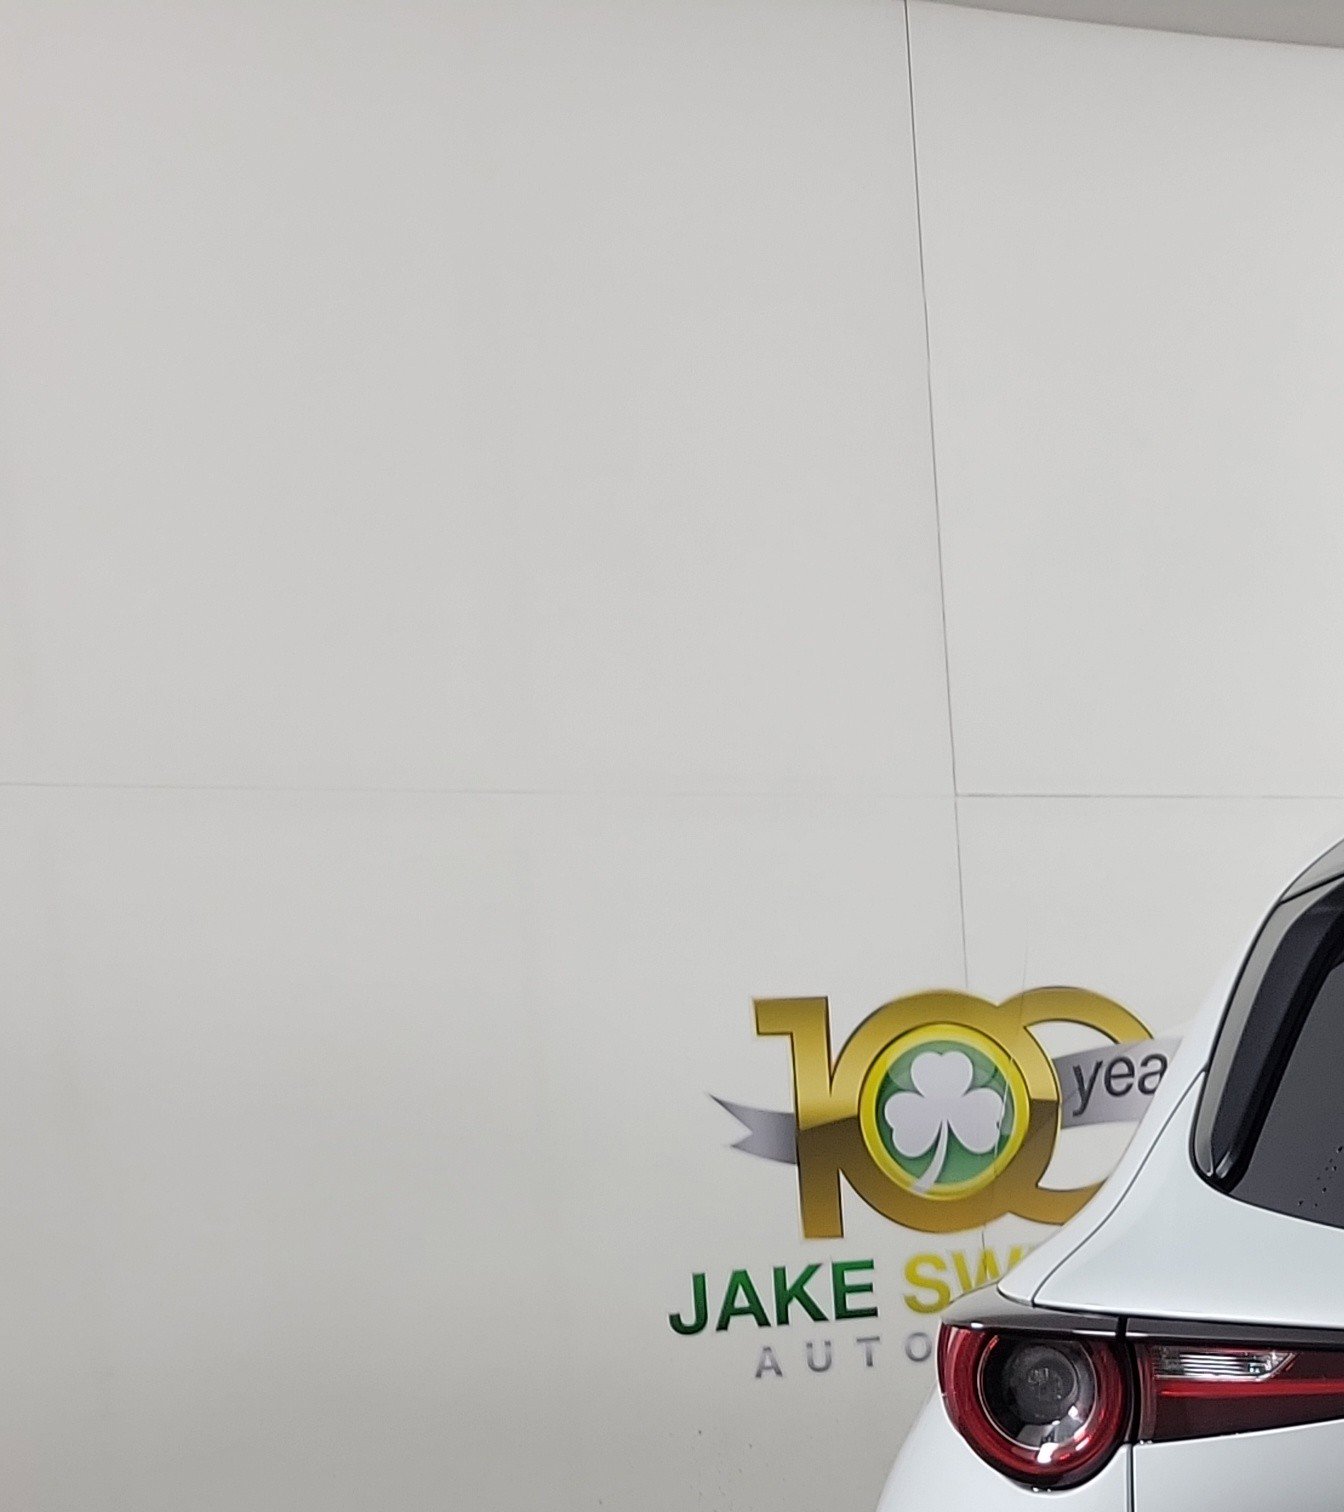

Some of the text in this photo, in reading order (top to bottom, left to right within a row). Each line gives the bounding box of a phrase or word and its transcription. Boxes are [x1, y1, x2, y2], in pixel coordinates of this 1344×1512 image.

[1072, 1053, 1168, 1117] yea
[668, 1258, 879, 1337] JAKE
[754, 1331, 932, 1379] AUTO
